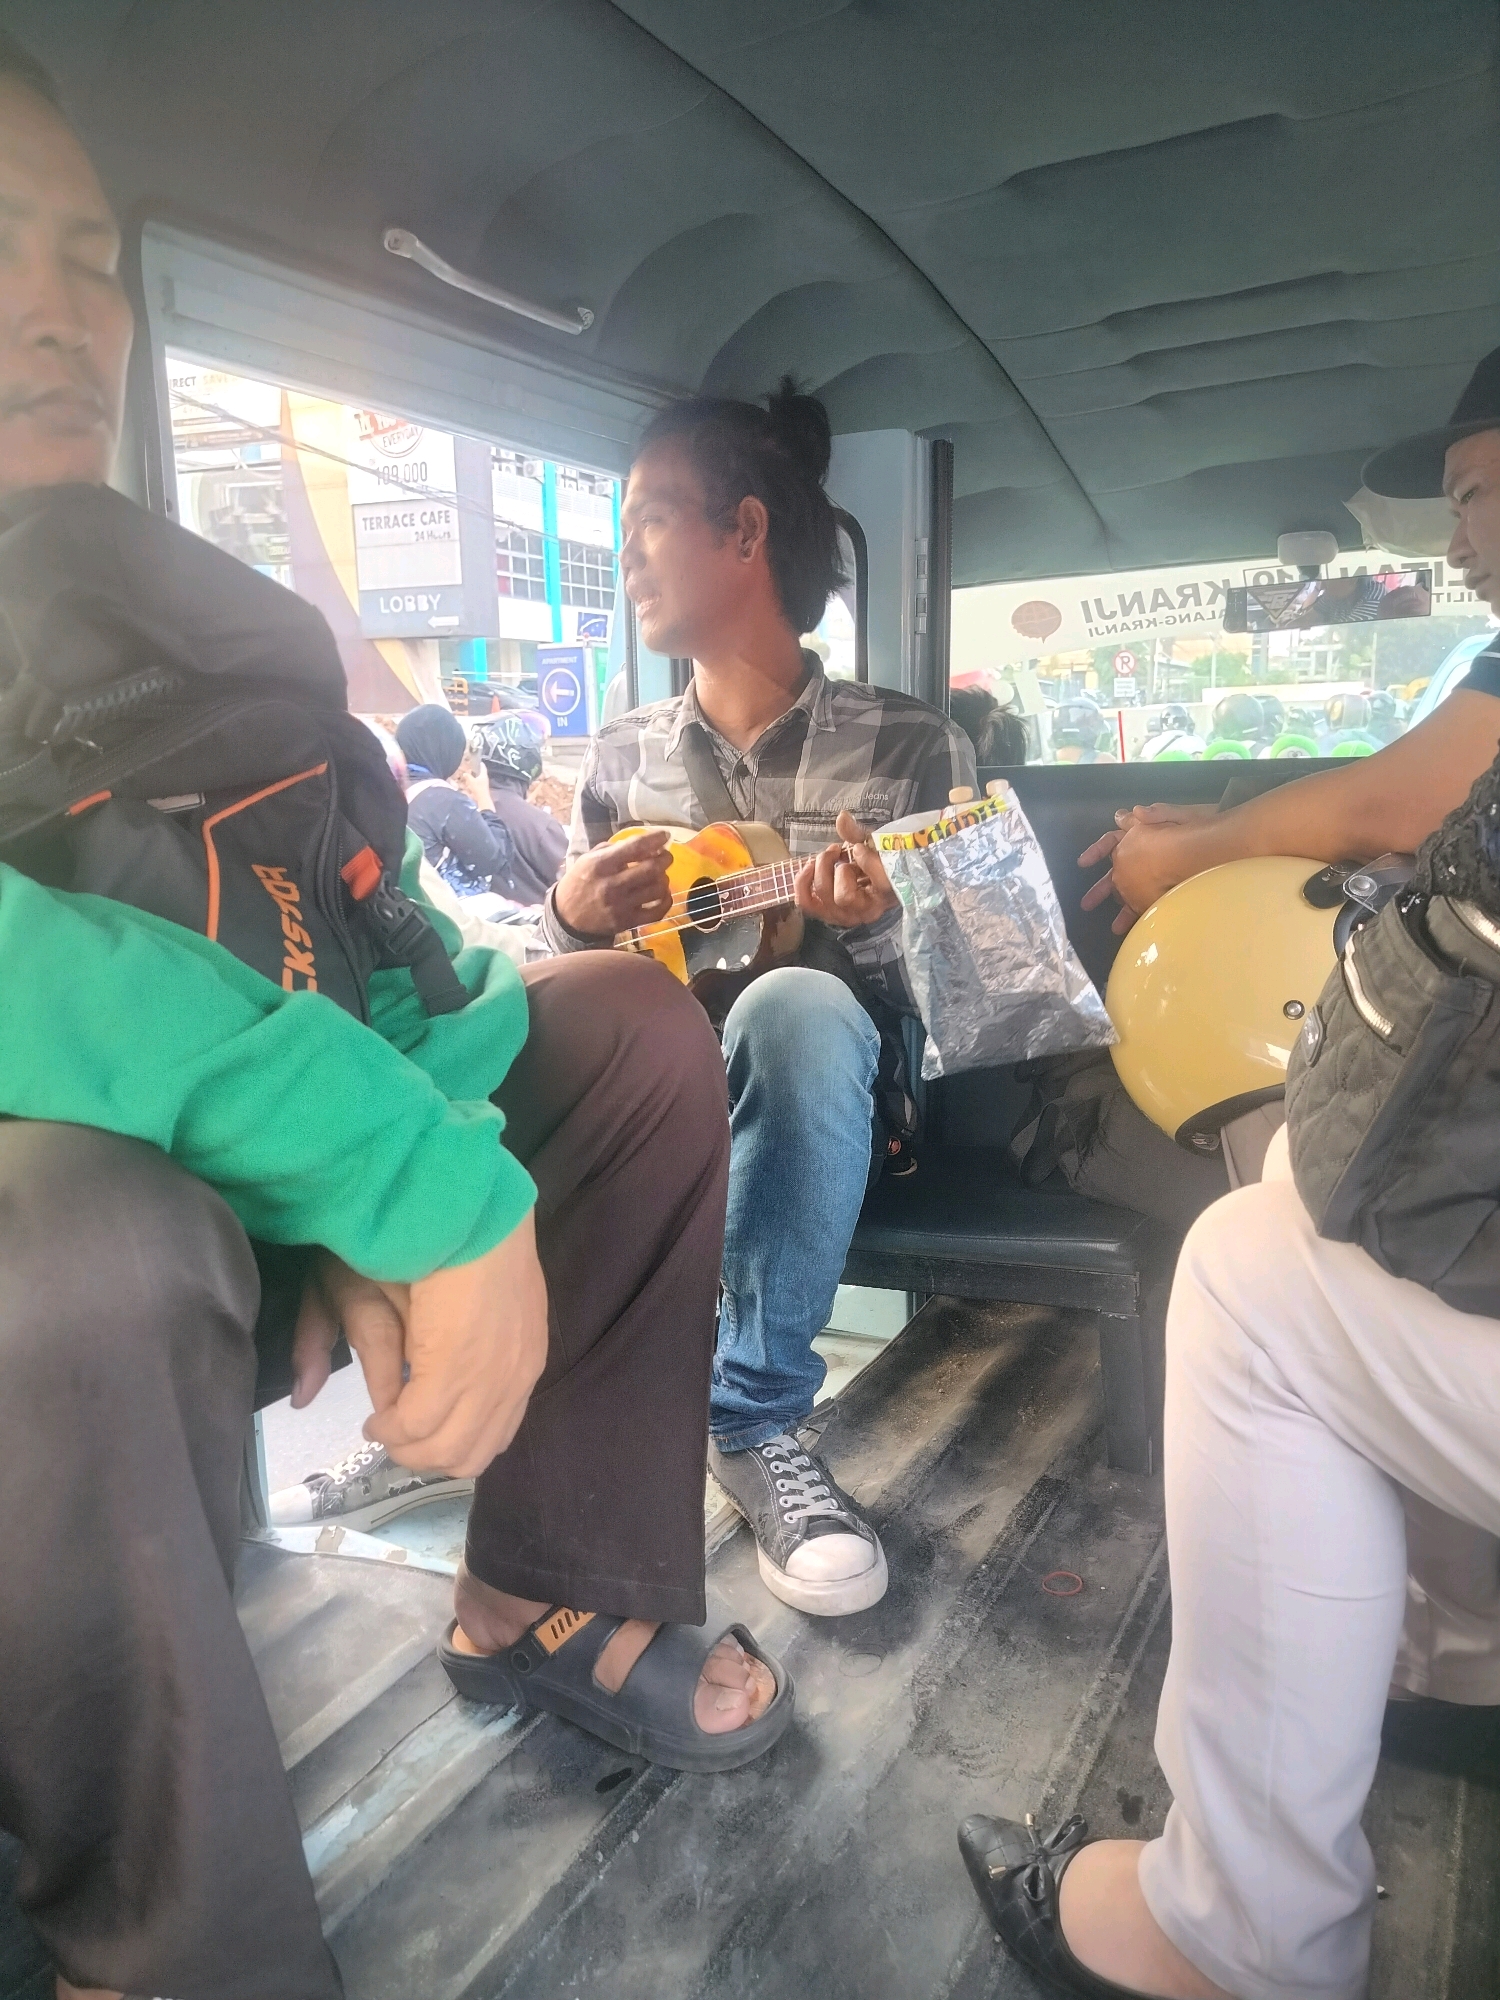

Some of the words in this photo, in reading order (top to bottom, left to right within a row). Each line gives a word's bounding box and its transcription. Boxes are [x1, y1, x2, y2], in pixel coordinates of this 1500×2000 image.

[362, 513, 416, 532] TERRACE
[420, 509, 451, 526] CAFE
[414, 530, 426, 542] 24
[427, 530, 451, 542] Hours
[380, 593, 441, 614] LOBBY
[557, 717, 569, 728] IN
[864, 791, 889, 801] Jeans
